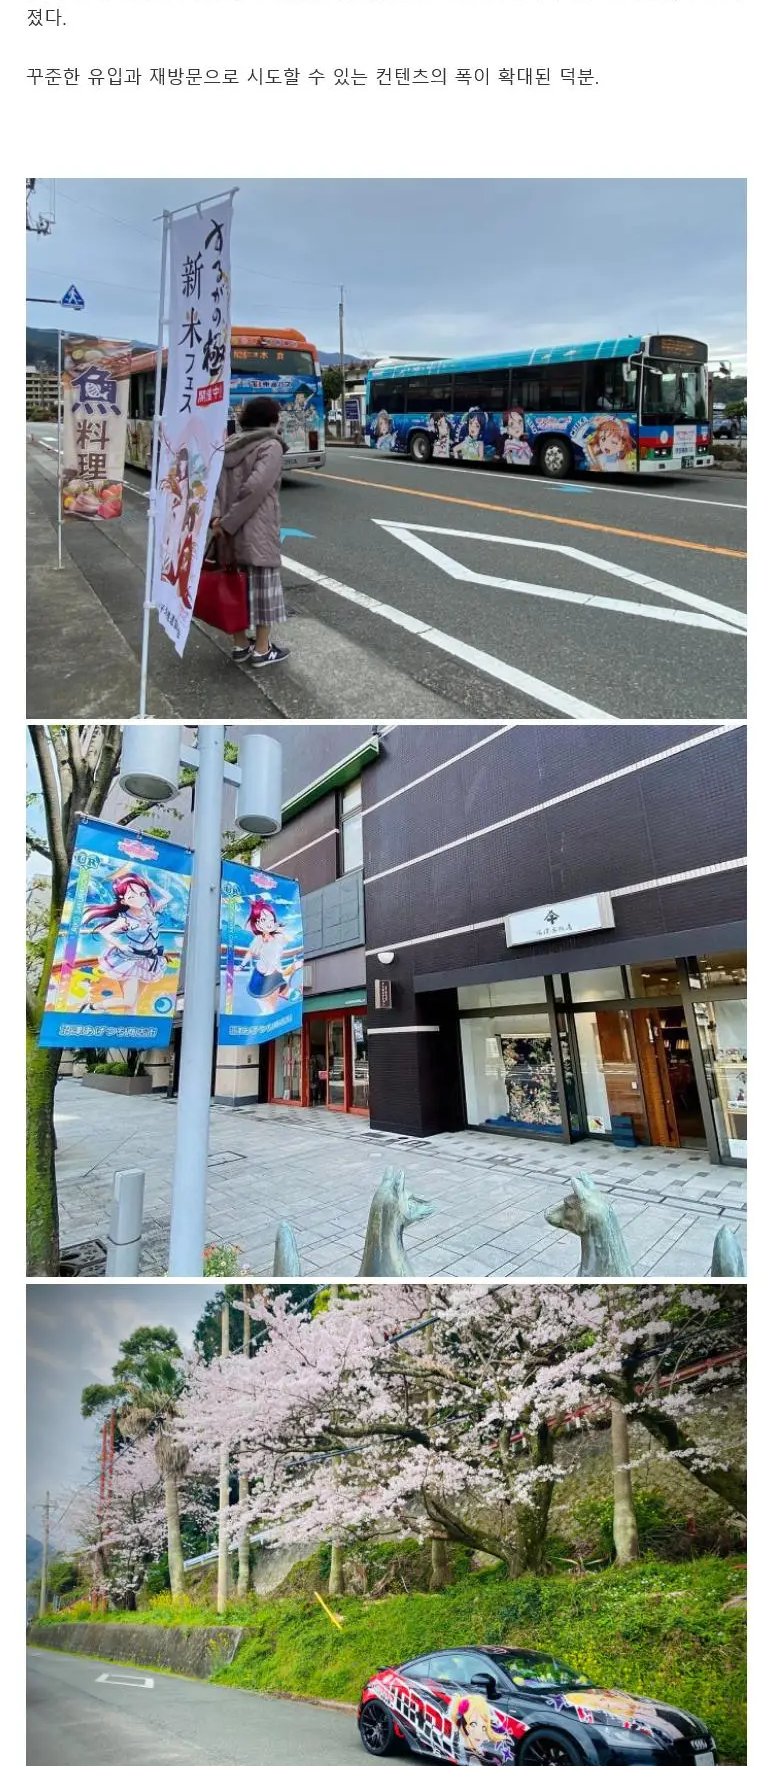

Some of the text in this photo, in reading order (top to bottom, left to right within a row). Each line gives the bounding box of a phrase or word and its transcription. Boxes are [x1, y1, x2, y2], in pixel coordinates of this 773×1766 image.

[178, 252, 203, 413] 新米フェス
[71, 366, 122, 480] 魚料理
